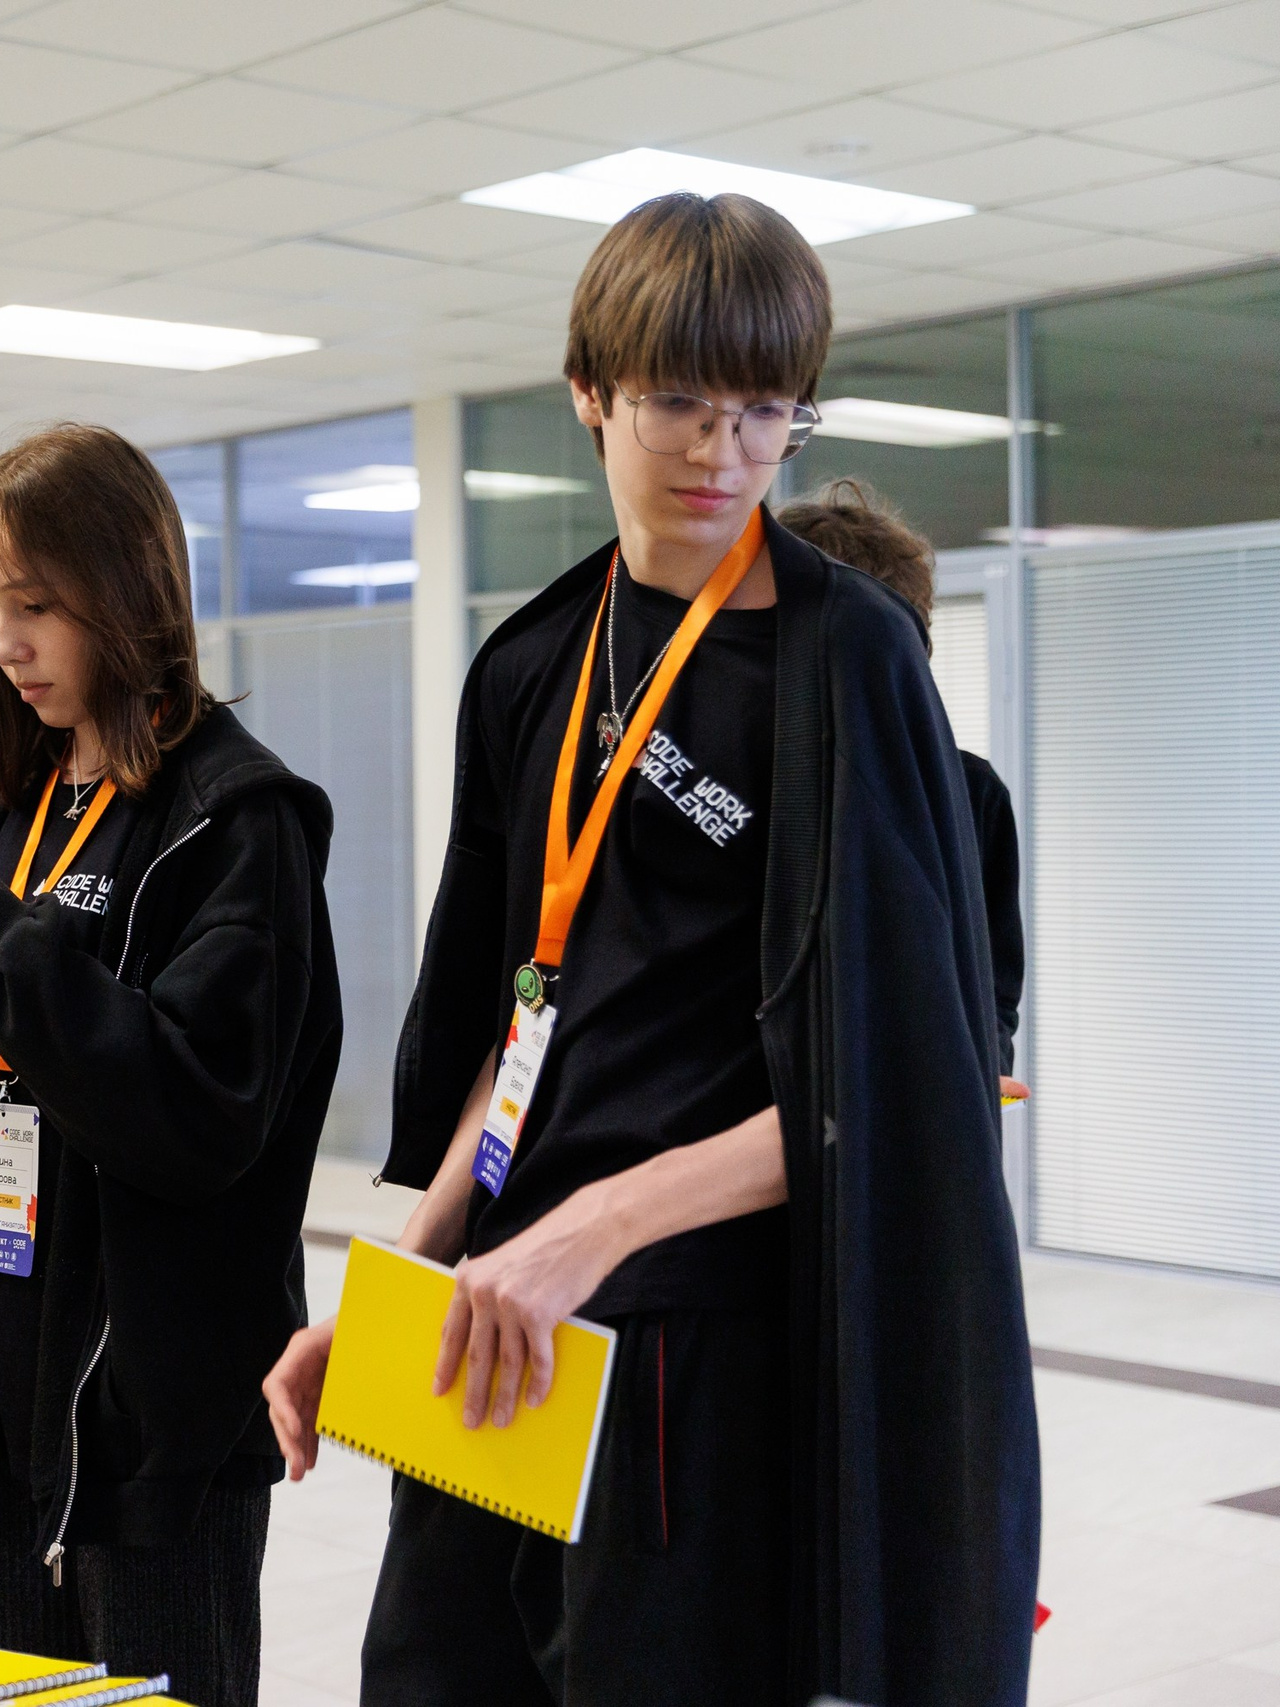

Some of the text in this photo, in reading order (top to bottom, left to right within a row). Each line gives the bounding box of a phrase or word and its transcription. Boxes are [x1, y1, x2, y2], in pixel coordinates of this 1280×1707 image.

[640, 754, 737, 848] HALLENGE
[693, 776, 753, 829] WORK
[57, 873, 97, 891] CODE
[529, 995, 544, 1013] DNS
